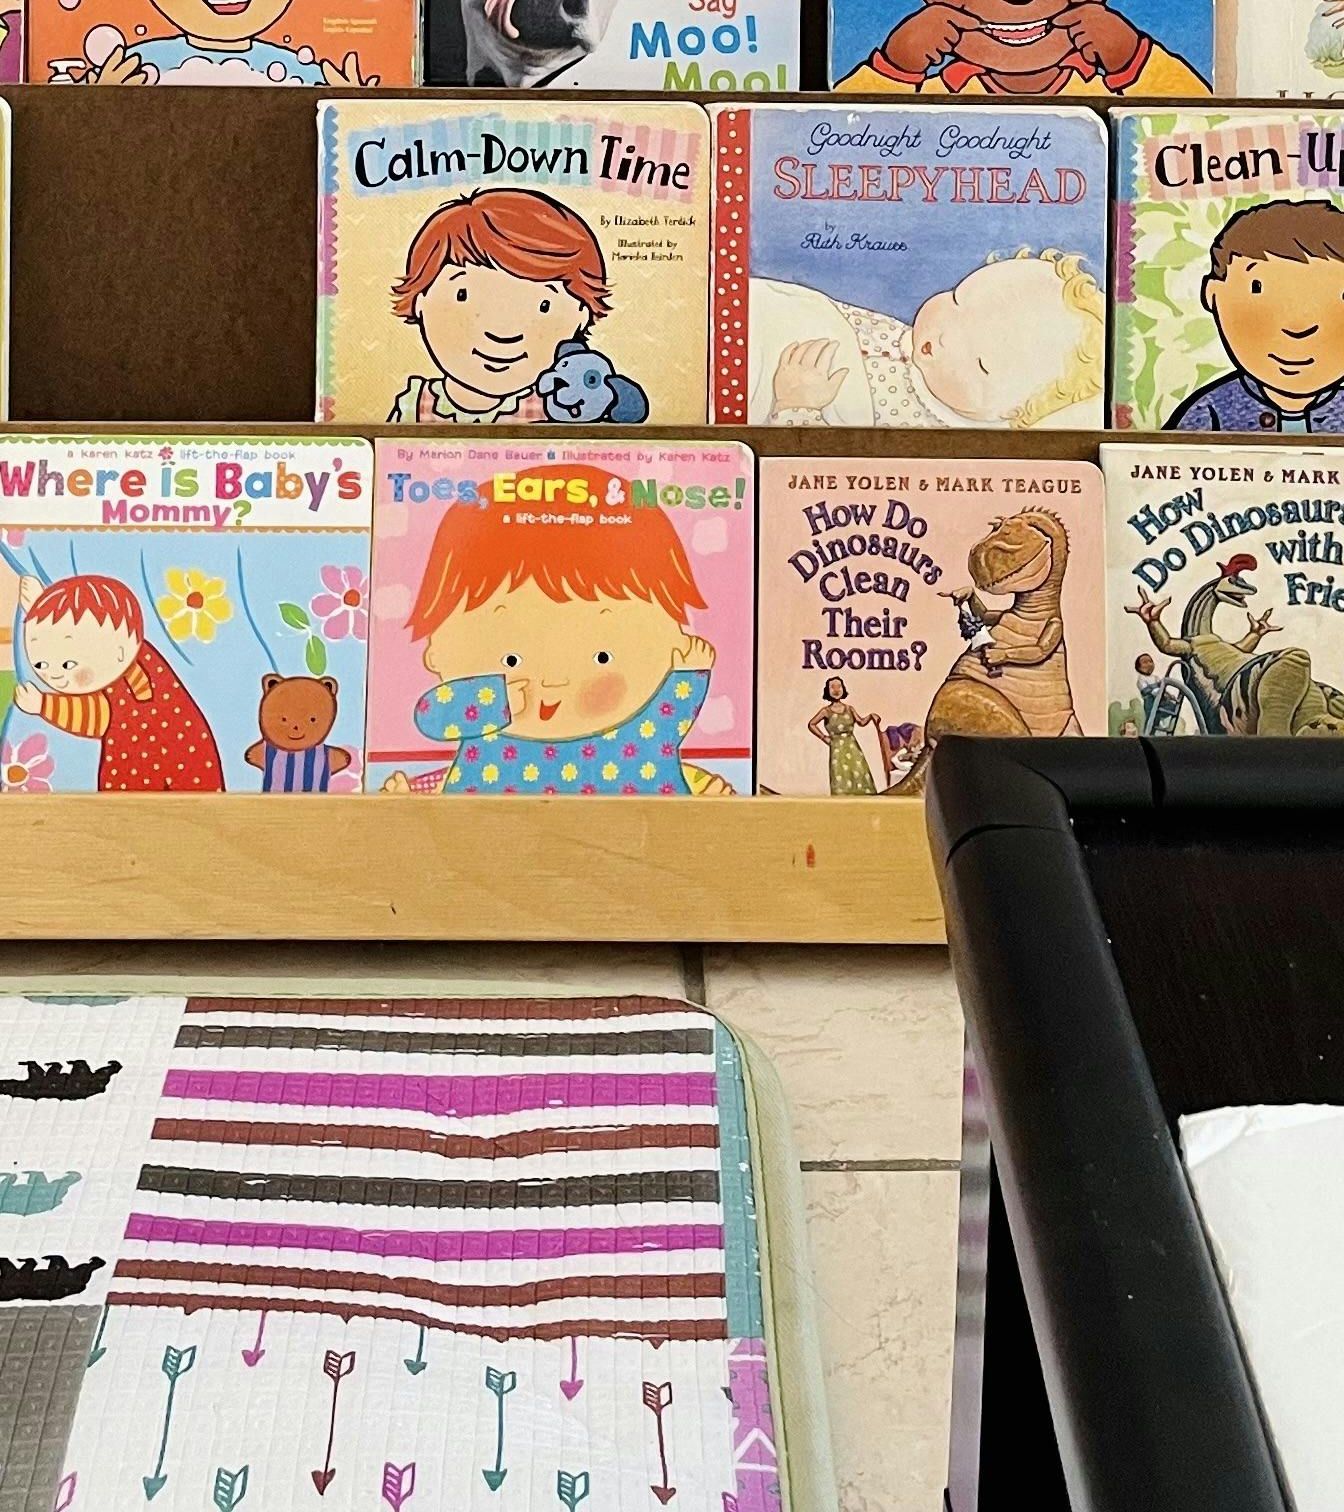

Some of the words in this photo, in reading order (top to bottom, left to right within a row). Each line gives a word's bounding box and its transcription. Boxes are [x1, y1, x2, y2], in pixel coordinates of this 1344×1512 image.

[630, 15, 758, 60] Moo!
[807, 122, 922, 158] Goodnight
[936, 125, 1051, 159] Goodnight
[355, 133, 588, 187] Calm-Down
[598, 135, 690, 189] Time
[773, 157, 1087, 205] SLEEPYHEAD
[600, 216, 611, 226] By
[614, 216, 660, 226] Elizabeth
[825, 221, 836, 232] by
[801, 232, 842, 250] Ruth
[846, 233, 908, 252] Krauss
[388, 472, 488, 510] Toes,
[493, 472, 598, 507] Ears,
[605, 477, 626, 506] &
[632, 477, 746, 510] Nose!
[1131, 464, 1180, 480] JANE
[1190, 467, 1254, 482] YOLEN
[1264, 470, 1273, 482] &
[1282, 470, 1340, 484] MARK
[803, 500, 876, 535] How
[882, 500, 928, 538] Do
[788, 535, 943, 585] Dinosaurs
[820, 565, 910, 602] Clean
[823, 608, 907, 637] Their
[802, 640, 928, 671] Rooms?
